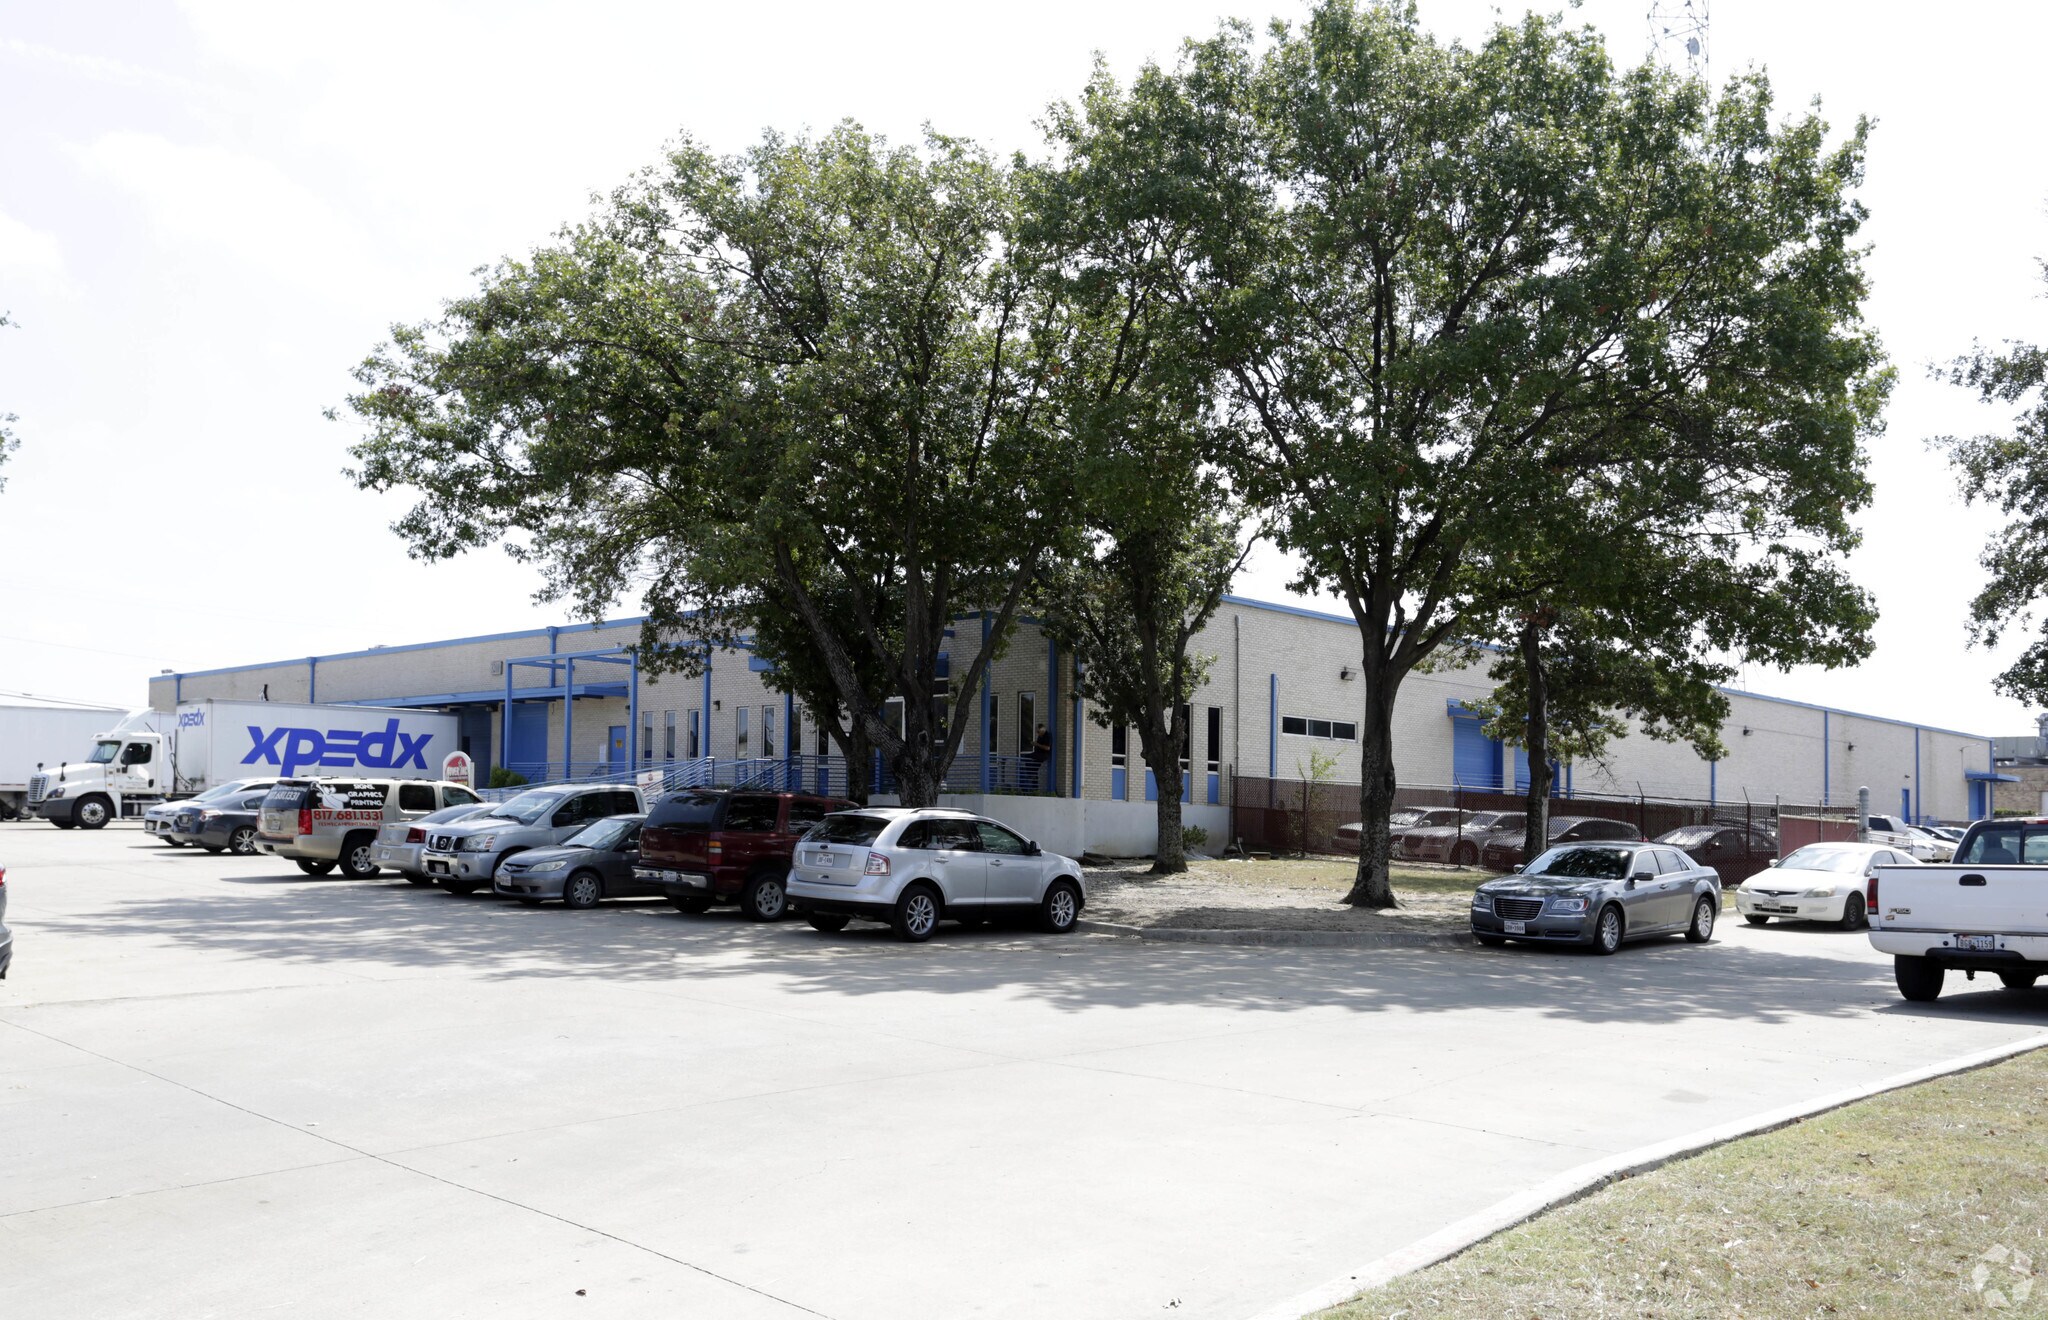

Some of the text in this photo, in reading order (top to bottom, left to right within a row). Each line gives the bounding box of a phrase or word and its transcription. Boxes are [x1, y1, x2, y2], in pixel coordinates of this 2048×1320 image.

[178, 708, 205, 731] xpedx
[240, 718, 434, 777] xpedx
[313, 810, 384, 821] 817.681.1331
